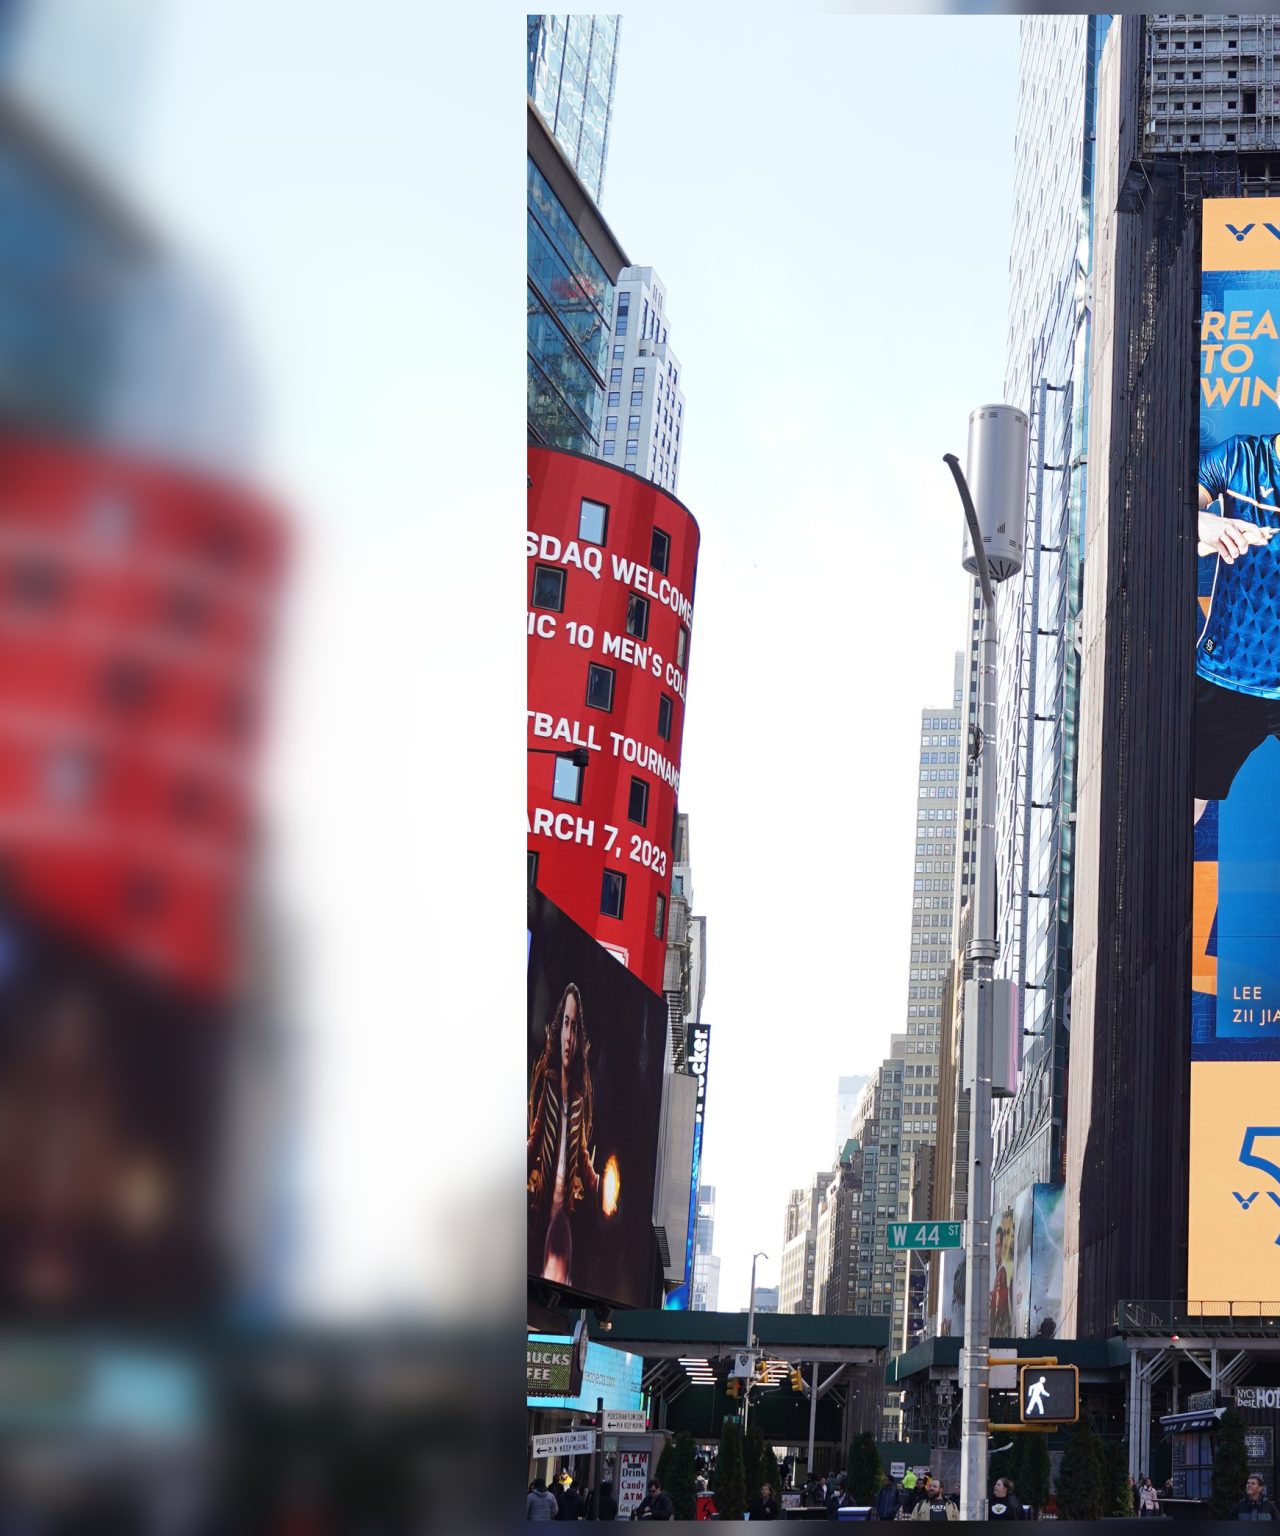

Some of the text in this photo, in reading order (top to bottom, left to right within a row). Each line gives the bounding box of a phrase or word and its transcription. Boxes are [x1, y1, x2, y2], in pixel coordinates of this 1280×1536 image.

[1201, 344, 1254, 374] TO
[1200, 377, 1280, 408] WIN
[527, 611, 557, 638] IC
[565, 621, 594, 648] 10
[602, 632, 662, 677] MEN'S
[527, 807, 667, 877] RCH 7, 2023
[1233, 986, 1262, 1000] LEE
[1233, 1009, 1253, 1023] ZII
[893, 1224, 959, 1246] W 44 ST
[1237, 1397, 1257, 1409] best
[536, 1436, 563, 1445] PEDESTRIAN
[564, 1435, 576, 1443] FLOW
[560, 1443, 588, 1452] KEEP MOVING
[623, 1453, 647, 1463] ATM
[622, 1467, 646, 1477] Drink
[621, 1480, 645, 1490] Candy
